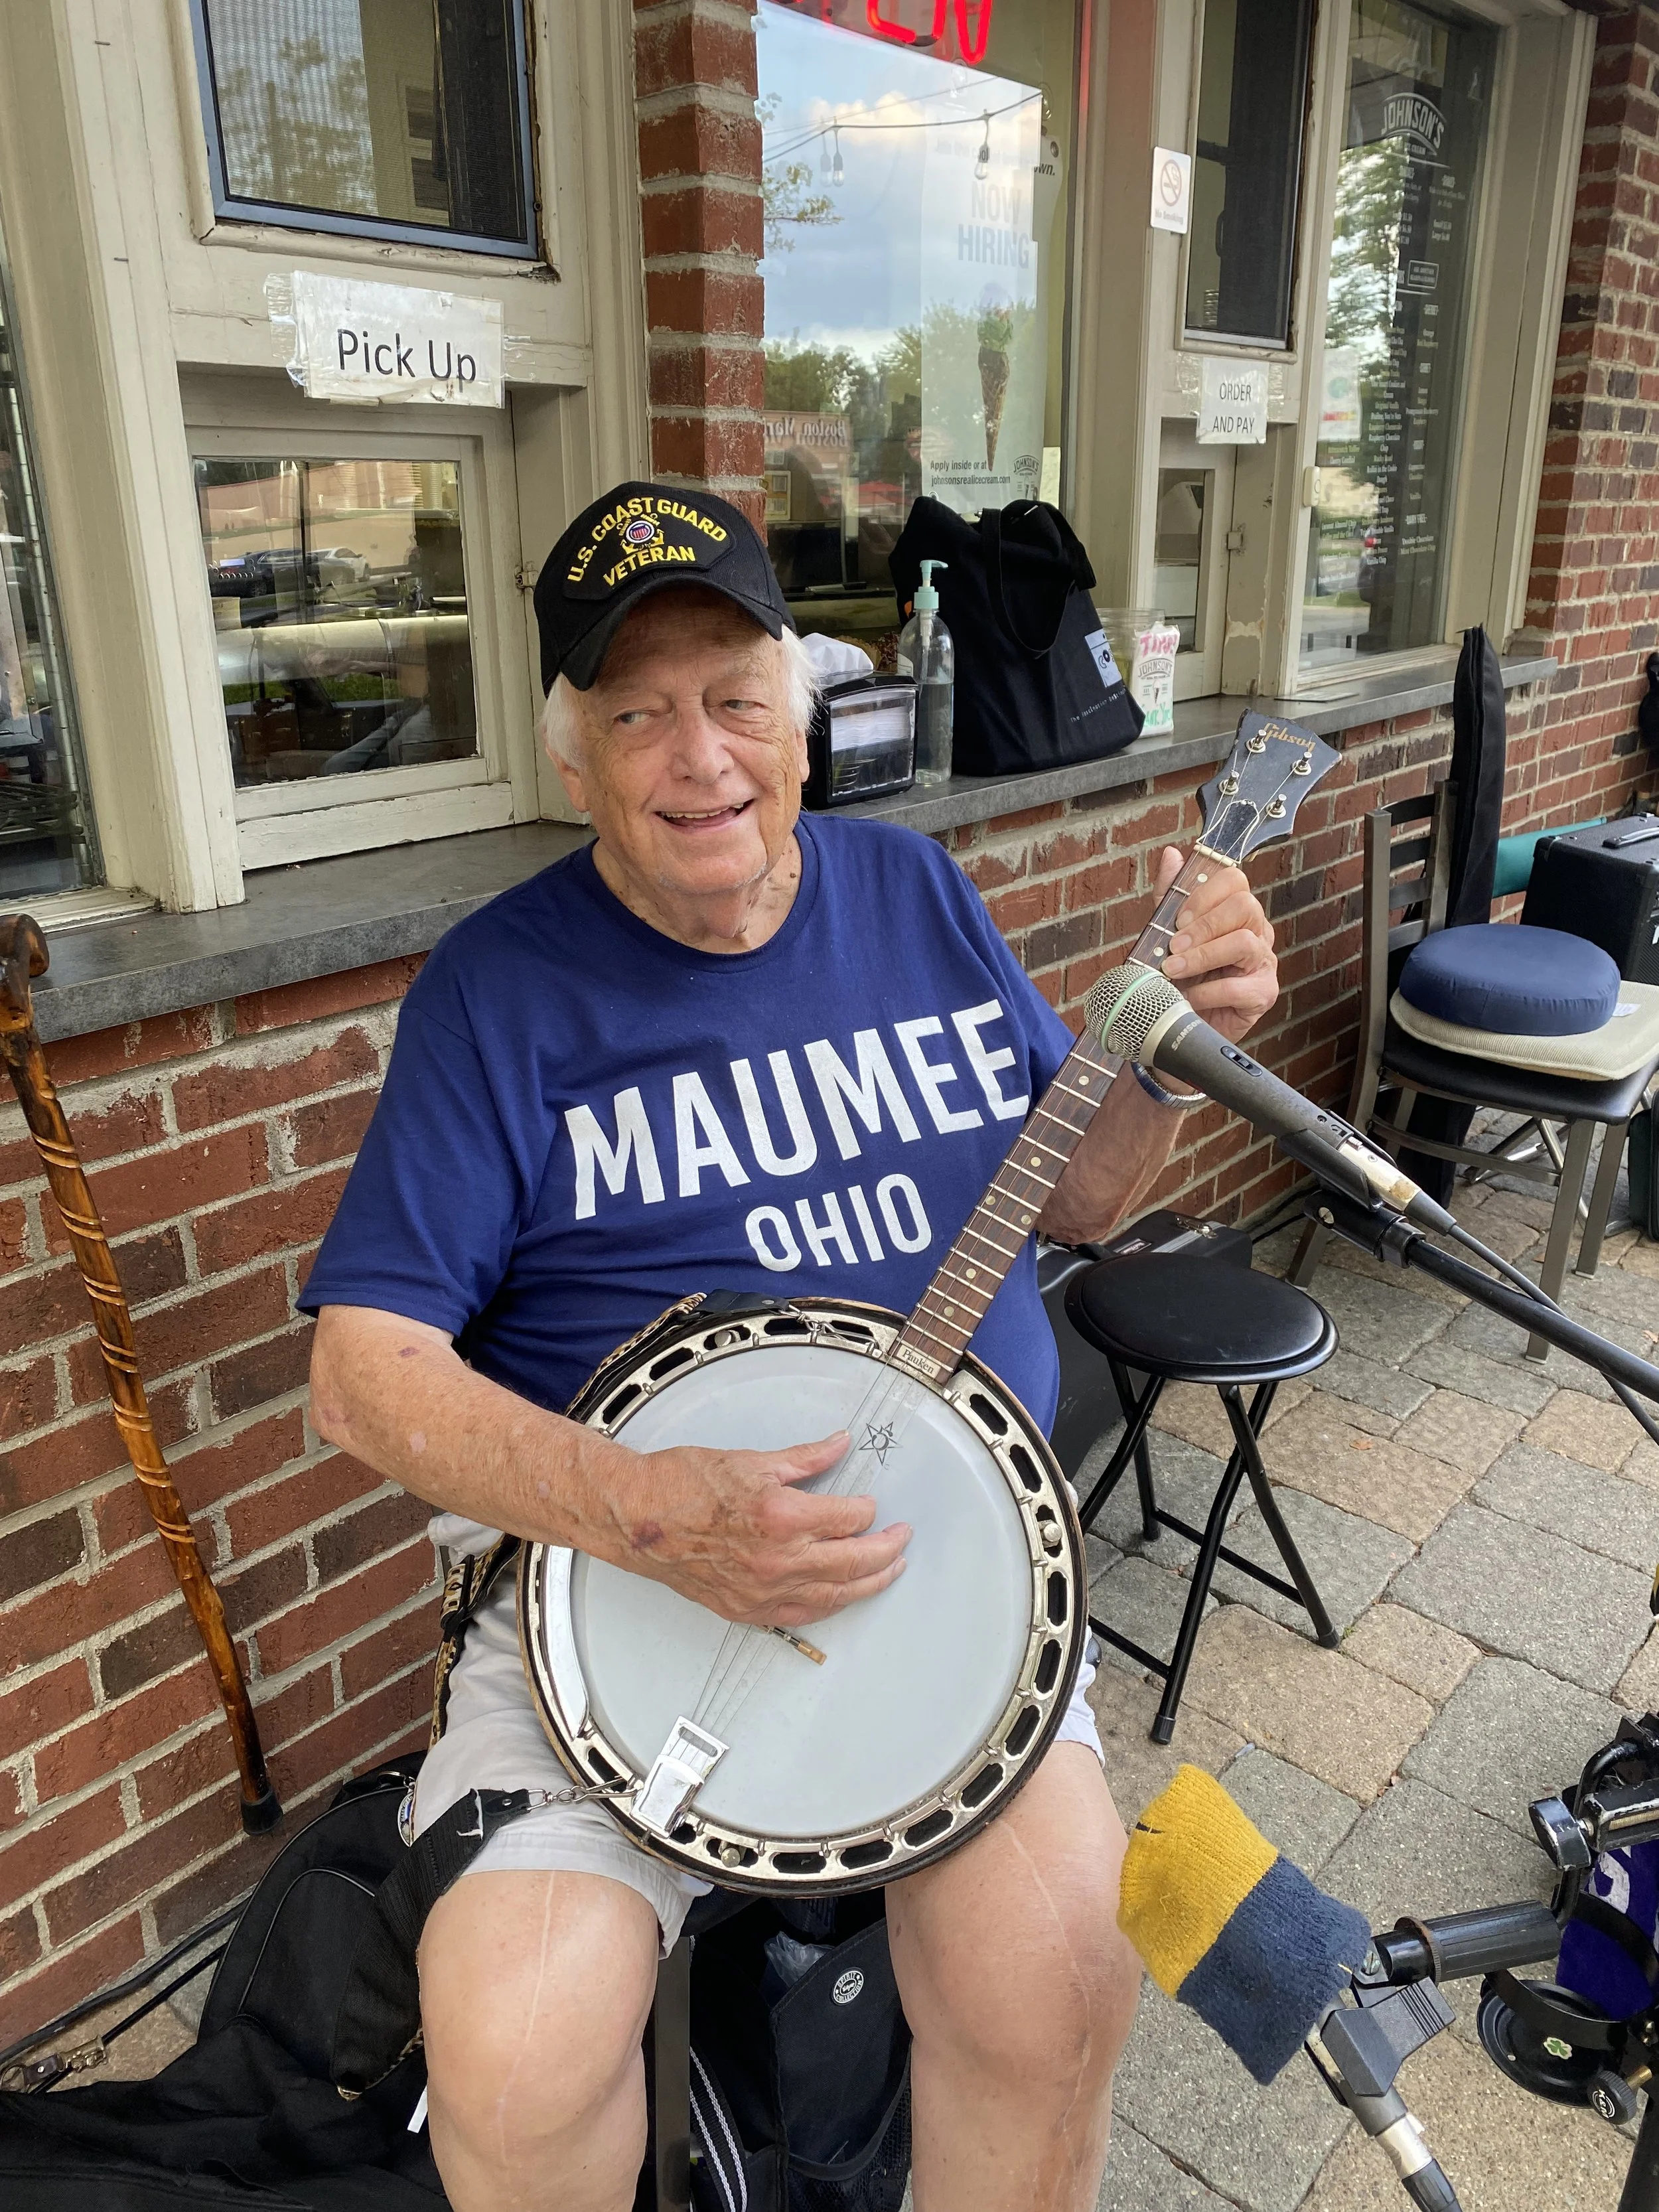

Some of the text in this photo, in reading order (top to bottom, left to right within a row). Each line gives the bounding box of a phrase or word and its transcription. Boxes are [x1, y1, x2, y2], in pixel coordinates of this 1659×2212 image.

[1381, 99, 1445, 149] JOHNSON'S
[972, 181, 1022, 224] NOW
[958, 224, 1029, 269] HIRING
[337, 329, 476, 393] Pick Up
[1220, 382, 1251, 402] ORDER
[1212, 416, 1255, 433] AND PAY
[930, 461, 949, 472] Apply
[952, 460, 972, 470] inside
[981, 461, 987, 470] at
[1013, 457, 1039, 474] JOHNSON'S
[931, 475, 1011, 486] johnsonsrealicecream.com
[567, 497, 727, 582] U.S. COAST GUARD
[603, 546, 696, 587] VETERAN
[1137, 659, 1173, 678] JOHNSON'S
[565, 999, 1031, 1219] MAUMEE
[745, 1173, 932, 1272] OHIO
[902, 1349, 934, 1374] Pauken
[836, 1980, 862, 2002] COLLECTION
[837, 1972, 856, 1988] SPIRIT
